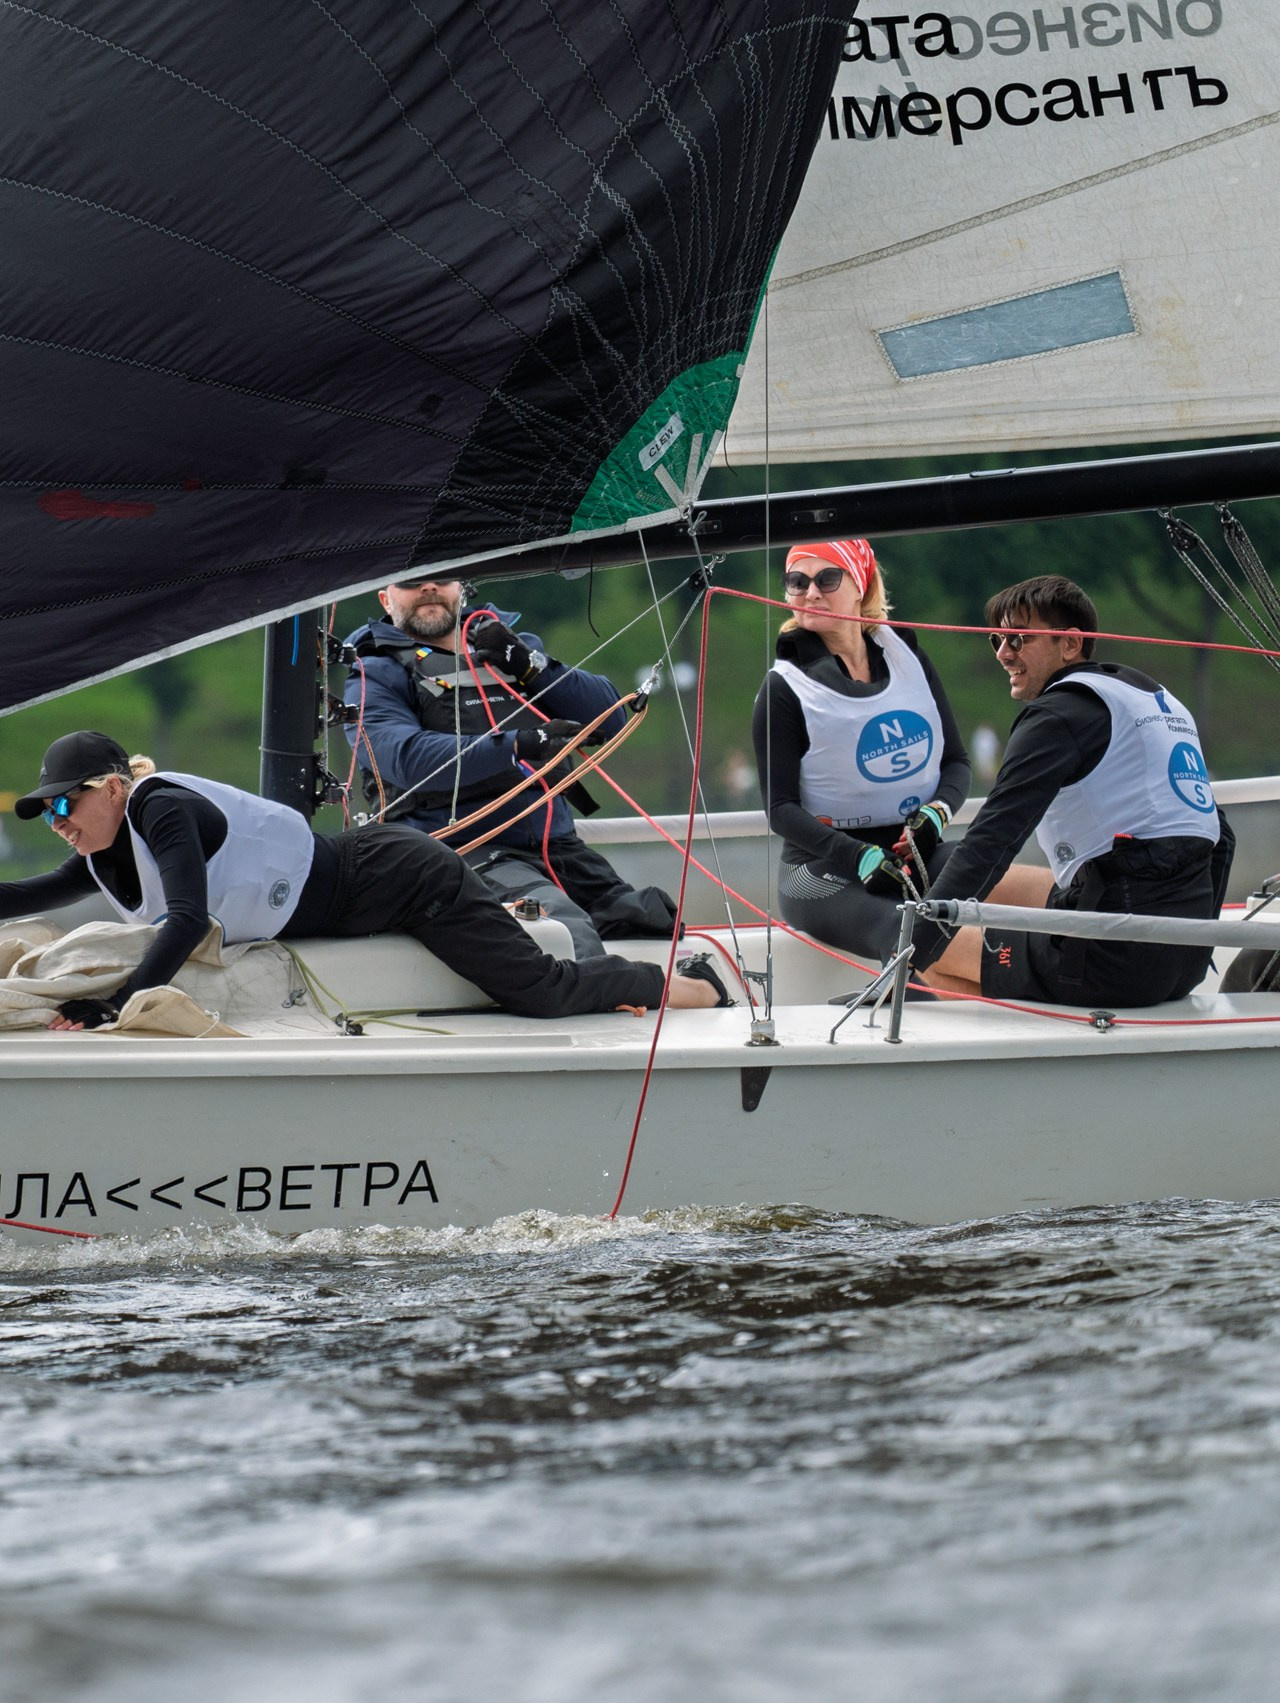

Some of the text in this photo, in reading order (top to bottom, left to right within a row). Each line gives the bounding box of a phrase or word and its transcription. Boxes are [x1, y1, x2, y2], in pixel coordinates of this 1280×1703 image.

[826, 65, 1228, 146] мерсантъ
[648, 425, 674, 458] CLEW
[879, 718, 904, 744] N
[861, 730, 929, 761] NORTH SAILS
[890, 751, 911, 774] S
[1182, 750, 1199, 772] N
[1194, 783, 1207, 805] S
